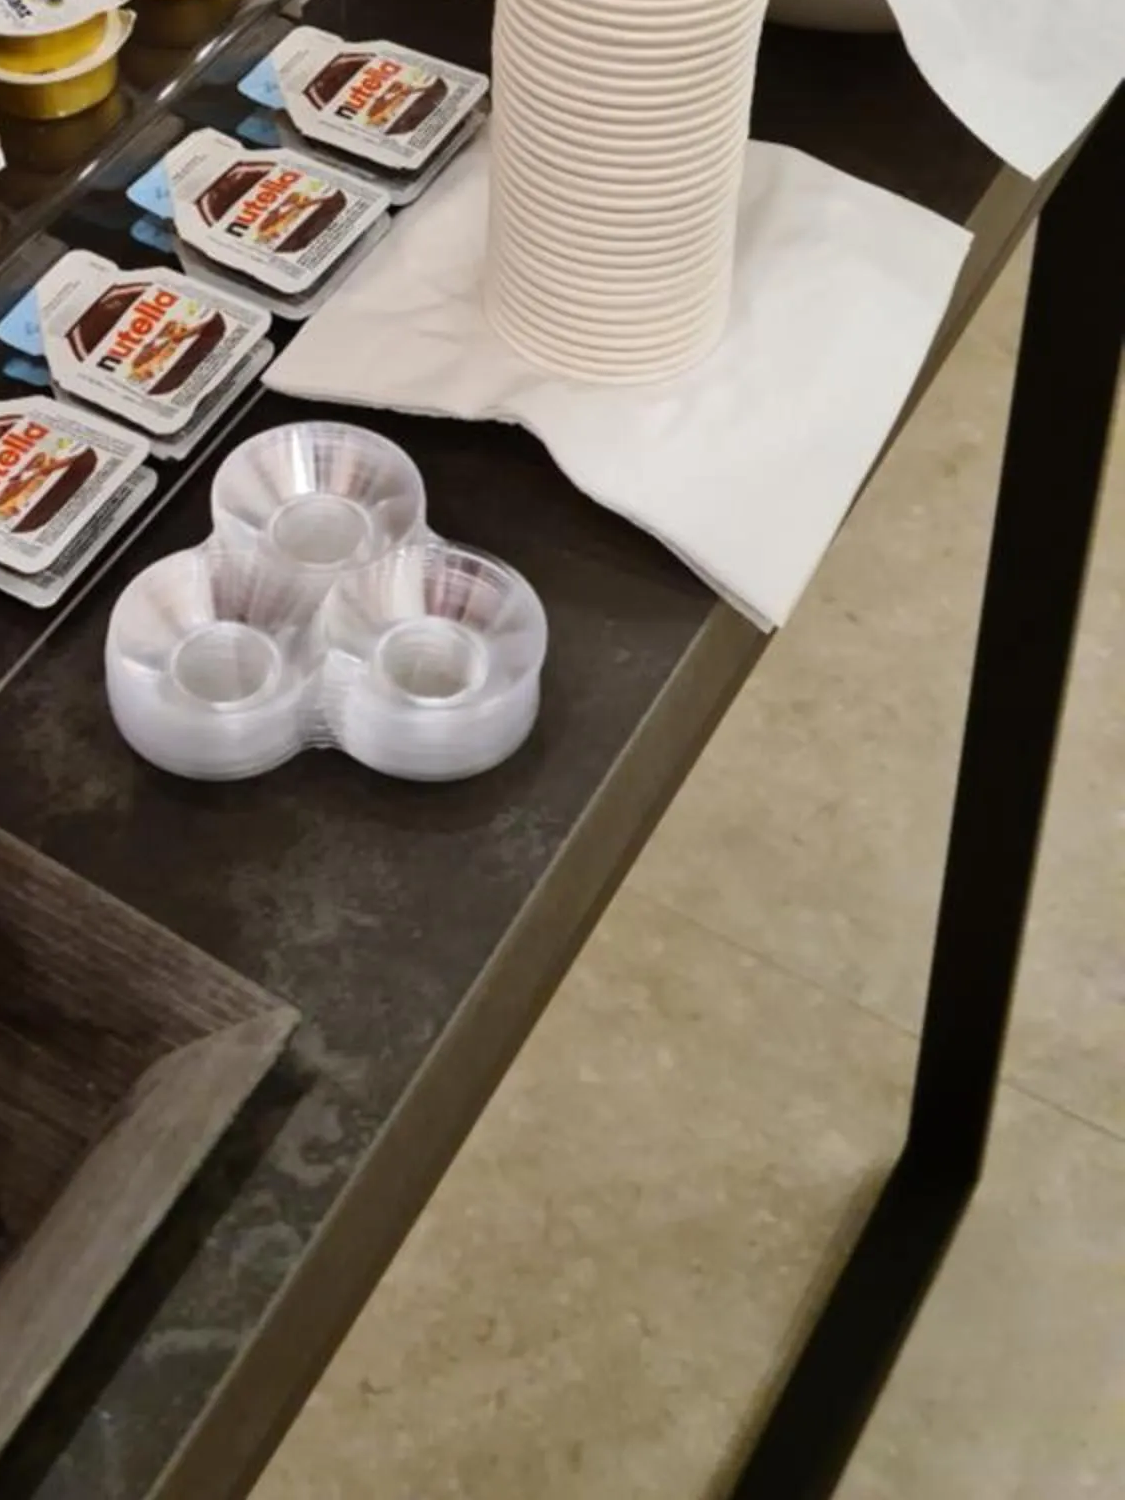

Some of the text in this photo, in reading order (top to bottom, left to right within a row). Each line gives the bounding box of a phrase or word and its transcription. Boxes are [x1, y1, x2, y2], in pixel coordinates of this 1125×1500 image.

[334, 59, 403, 120] nutella
[225, 169, 304, 238] nutella
[96, 289, 180, 372] nutella
